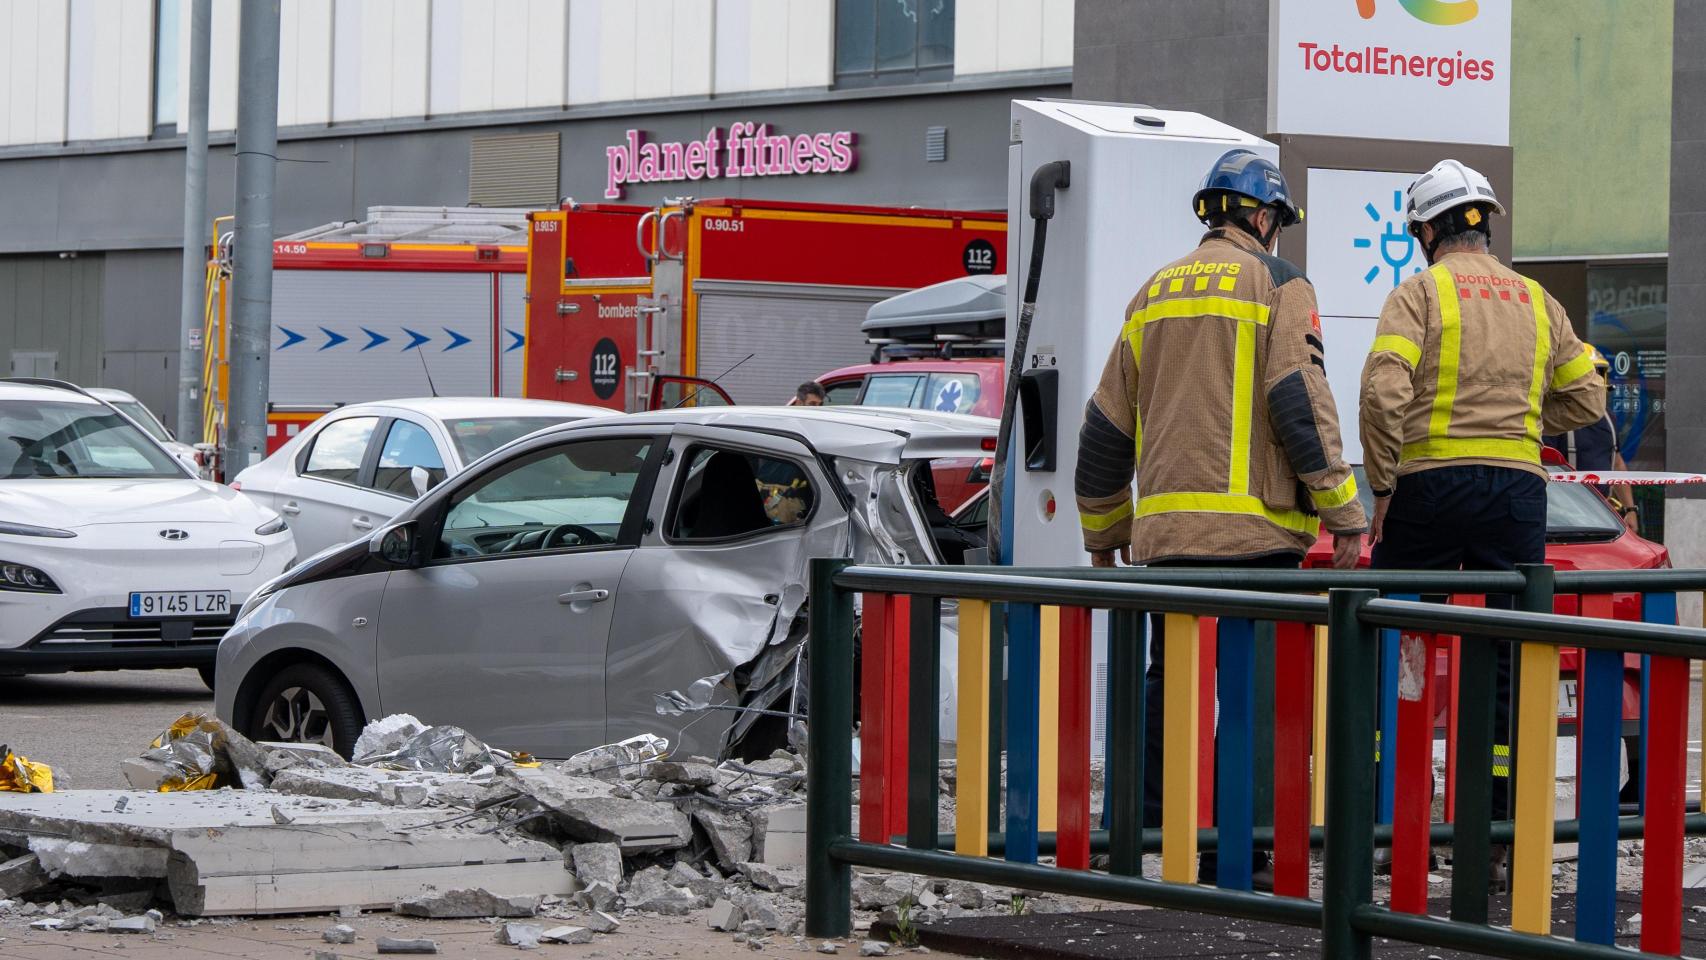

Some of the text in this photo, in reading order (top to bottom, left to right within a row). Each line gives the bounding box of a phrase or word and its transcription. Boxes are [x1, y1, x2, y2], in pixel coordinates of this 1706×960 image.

[1298, 42, 1494, 87] TotalEnergies
[604, 121, 854, 199] planet fitness
[704, 218, 745, 232] 0.90.51
[967, 248, 992, 264] 112
[1153, 260, 1242, 283] bombers
[1455, 272, 1527, 289] bombers
[598, 303, 639, 318] bombers
[594, 353, 616, 375] 112
[143, 594, 227, 613] 9145 LZR
